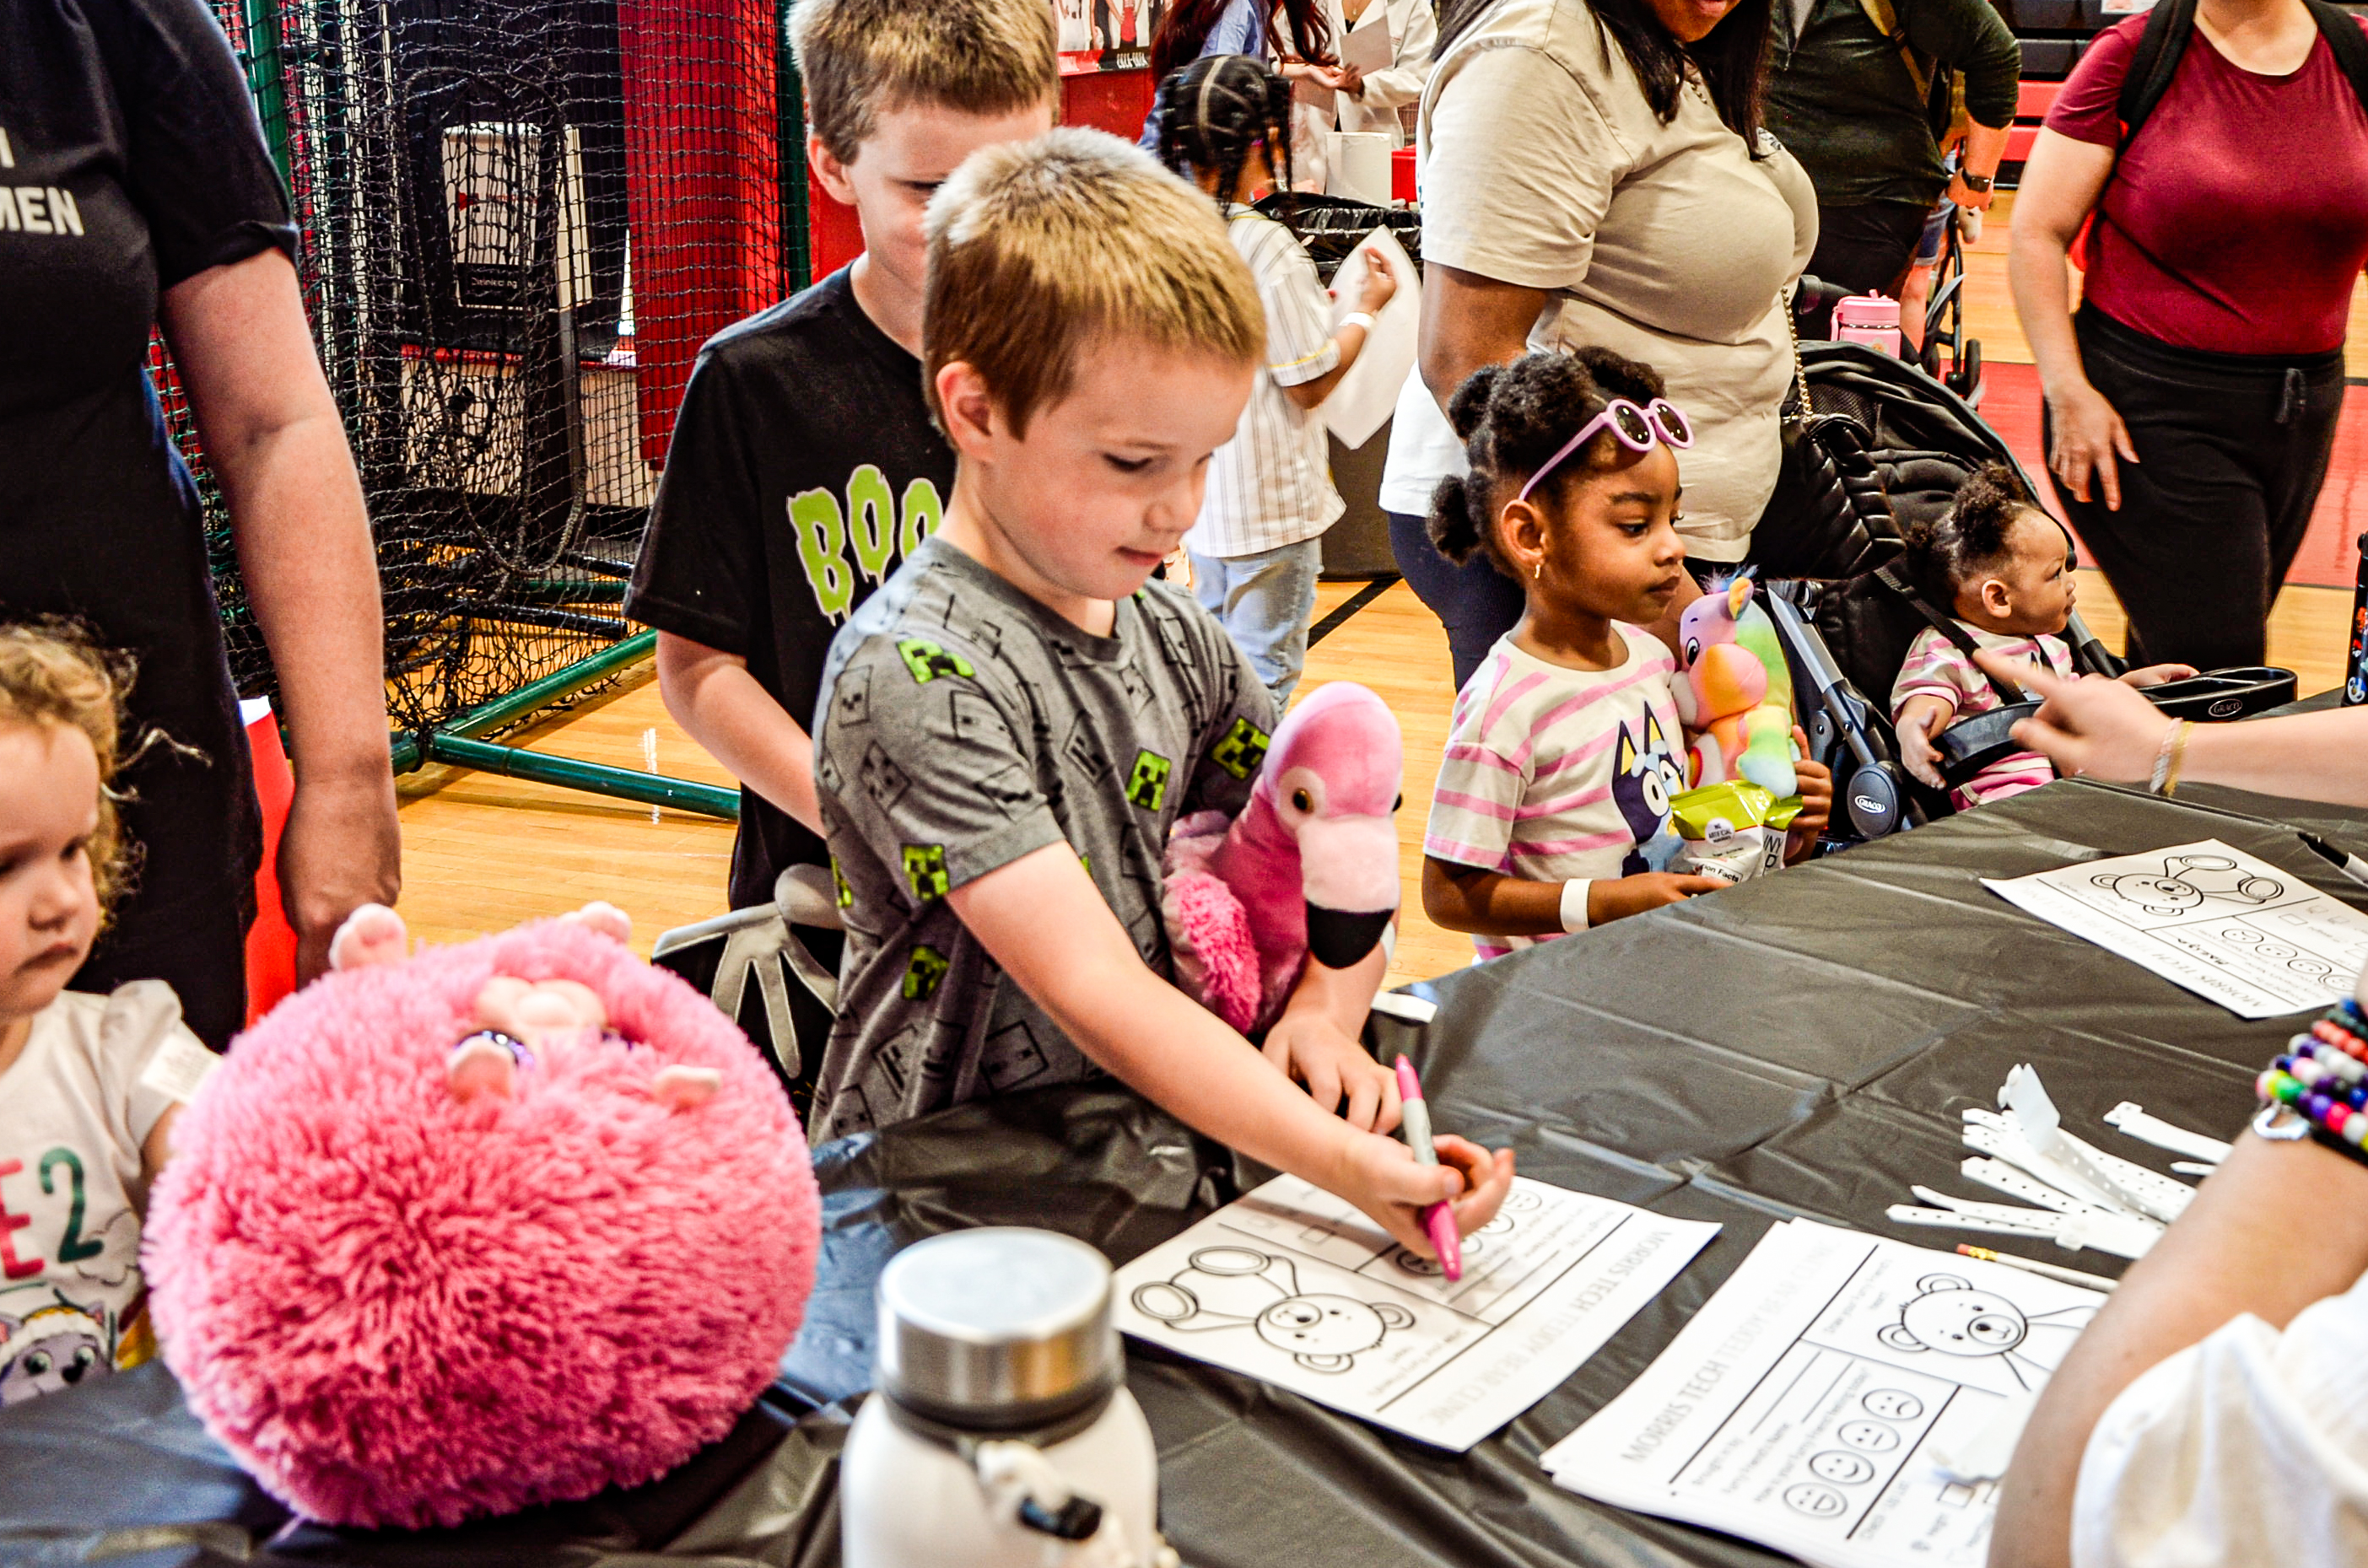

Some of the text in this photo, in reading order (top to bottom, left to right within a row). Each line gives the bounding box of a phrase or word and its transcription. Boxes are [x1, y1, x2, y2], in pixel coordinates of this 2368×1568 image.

[2214, 701, 2241, 714] GRACO
[1858, 797, 1883, 812] GRACO
[1604, 1228, 1675, 1277] MORRIS
[1564, 1275, 1623, 1312] TECH
[1617, 1398, 1696, 1464] MORRIS
[1675, 1359, 1733, 1402] TECH
[1713, 1312, 1775, 1361] TEDDY
